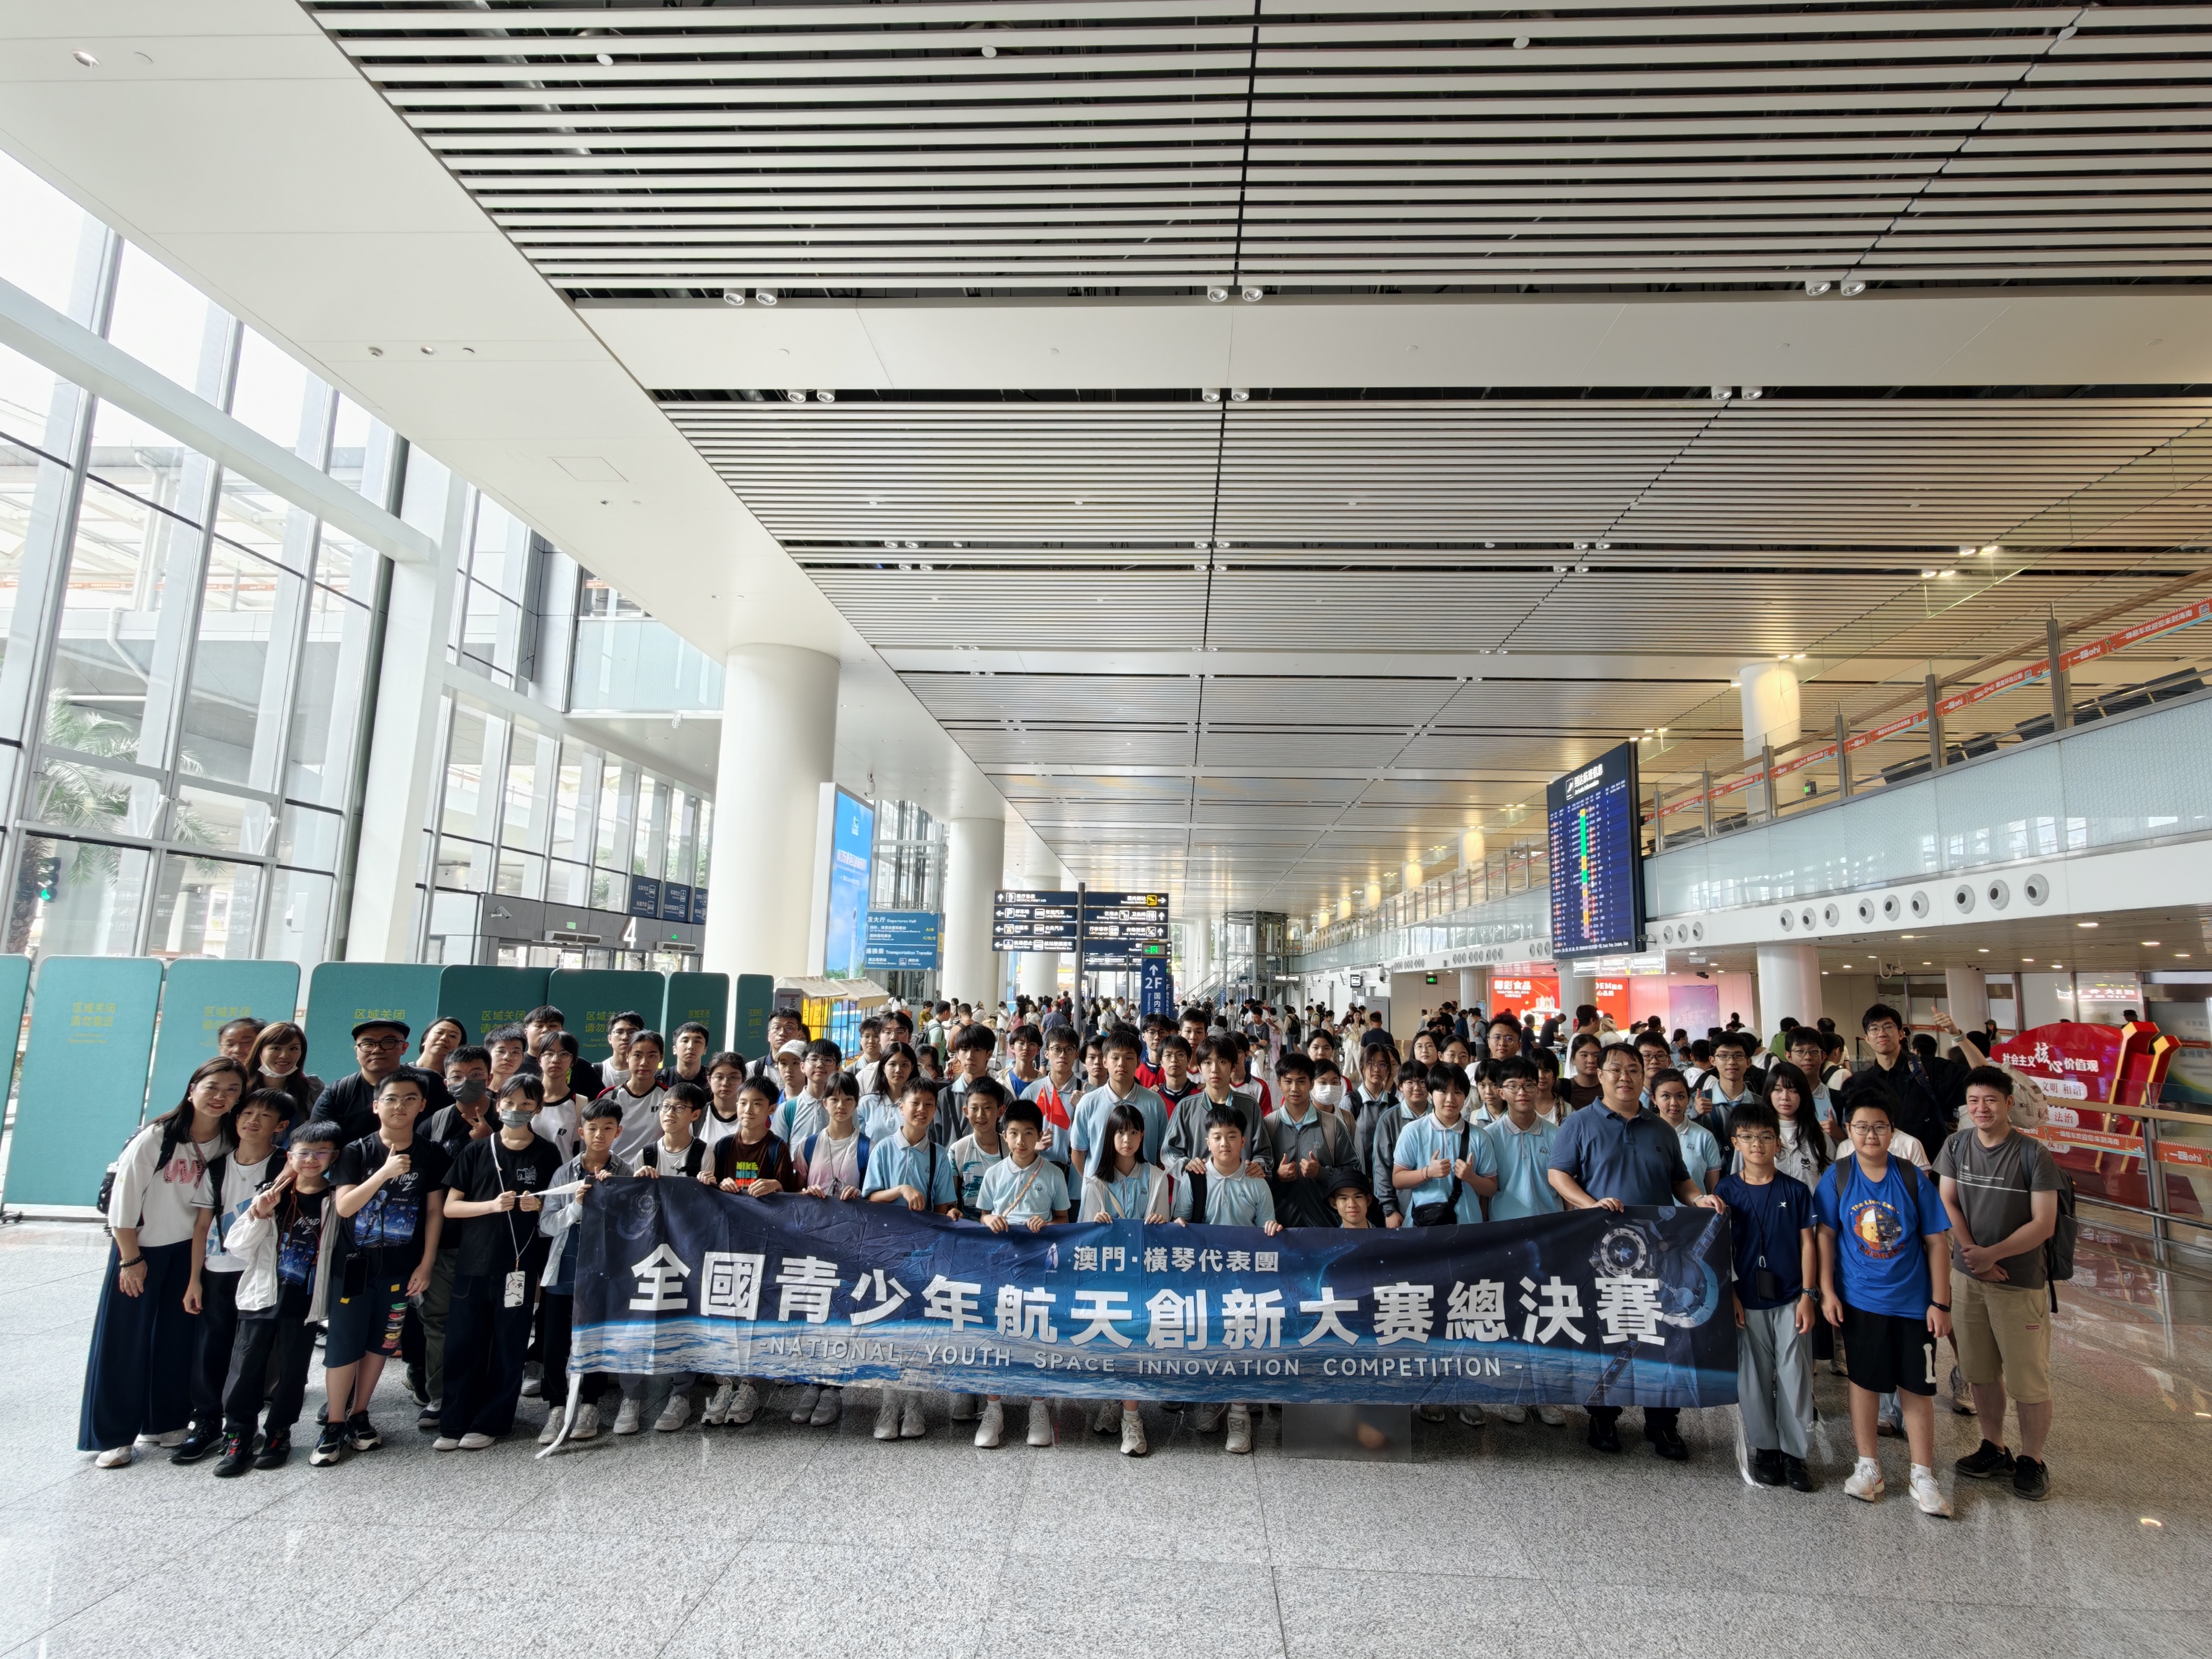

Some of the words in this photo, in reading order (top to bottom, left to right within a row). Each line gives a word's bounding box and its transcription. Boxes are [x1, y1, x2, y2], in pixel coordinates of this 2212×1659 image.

[1574, 764, 1603, 788] 到达航班信息
[623, 916, 637, 949] 4
[1144, 977, 1163, 989] 2F
[354, 1009, 406, 1020] 区域关闭
[481, 1010, 526, 1021] 区域关闭
[2002, 1042, 2099, 1074] 社会主义核心价值观
[2042, 1082, 2058, 1094] 文明
[2062, 1083, 2082, 1097] 和谐
[2054, 1111, 2074, 1124] 法治
[557, 1128, 567, 1136] KP
[736, 1161, 759, 1170] NIKE
[736, 1170, 758, 1178] NIKE
[1851, 1202, 1864, 1211] The
[629, 1243, 1665, 1350] 全國青少年航天創新大賽總決賽
[926, 1344, 1011, 1367] YOUTH
[1034, 1351, 1116, 1372] SPACE
[1139, 1358, 1299, 1377] INNOVATION
[1323, 1357, 1502, 1377] COMPETITION
